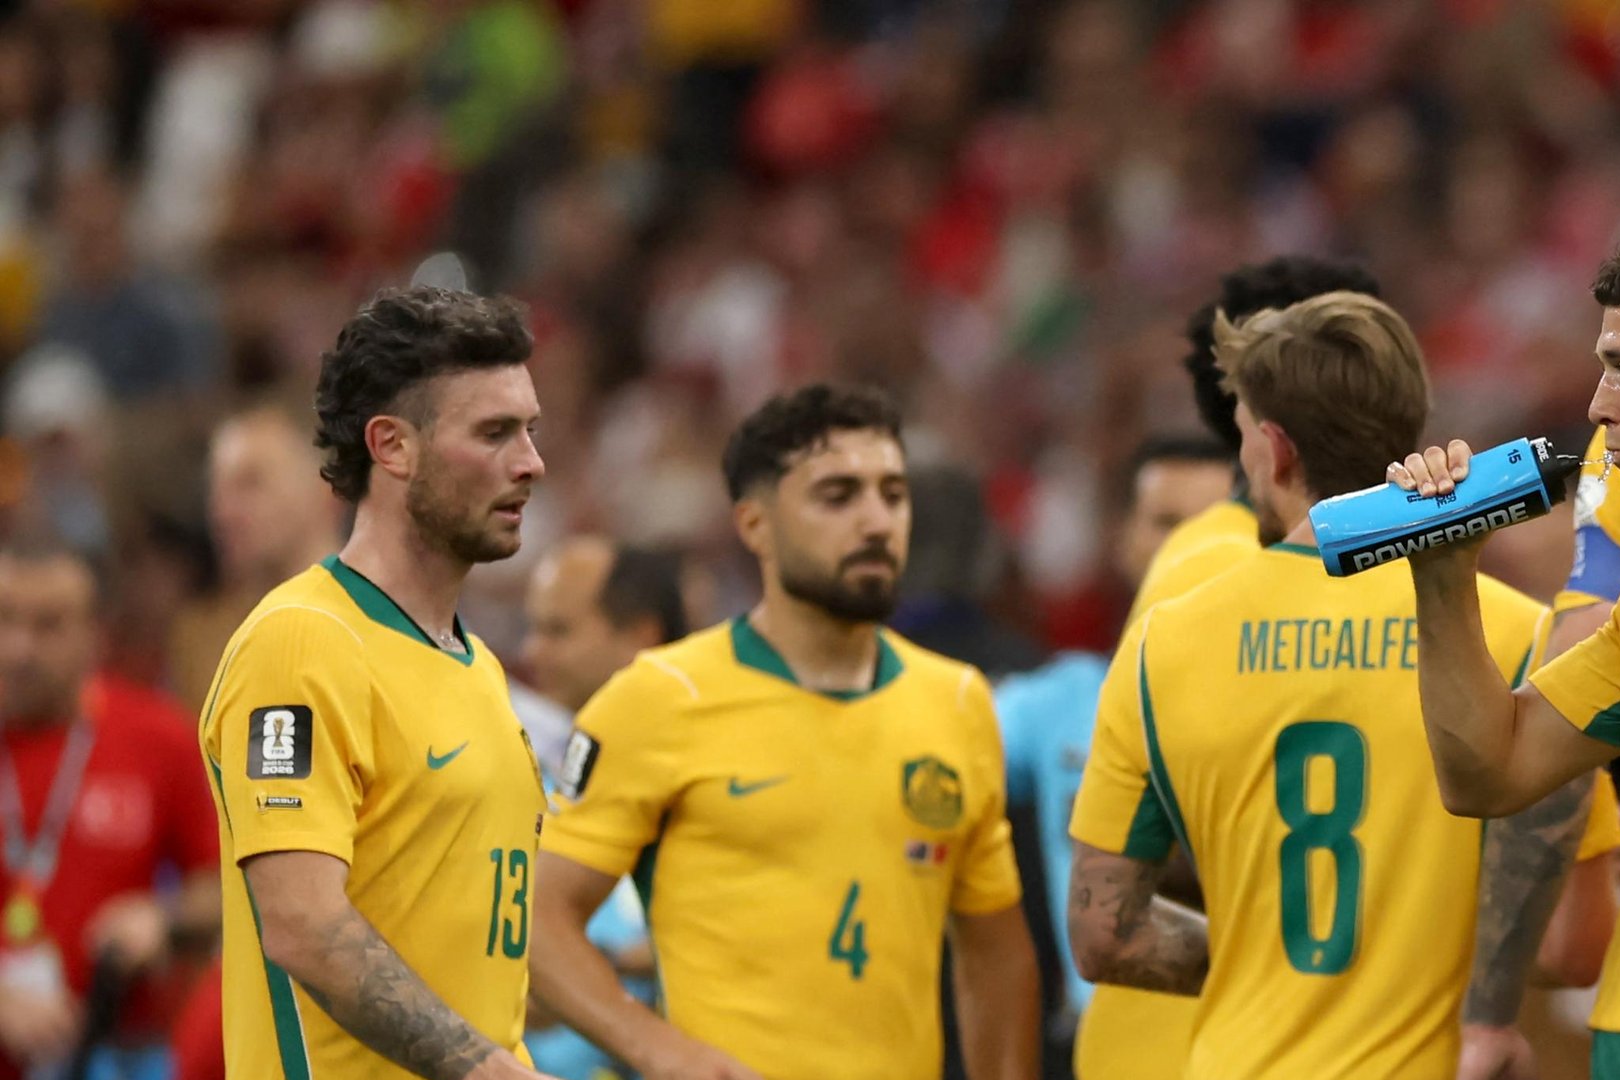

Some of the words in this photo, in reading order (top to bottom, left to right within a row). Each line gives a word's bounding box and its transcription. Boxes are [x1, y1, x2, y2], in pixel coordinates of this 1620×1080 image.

[1507, 448, 1522, 465] 15
[1352, 501, 1530, 573] POWERADE
[1237, 617, 1418, 674] METCALFE
[261, 765, 295, 775] 2026
[1274, 720, 1369, 976] 8
[486, 848, 528, 960] 13
[828, 880, 870, 980] 4
